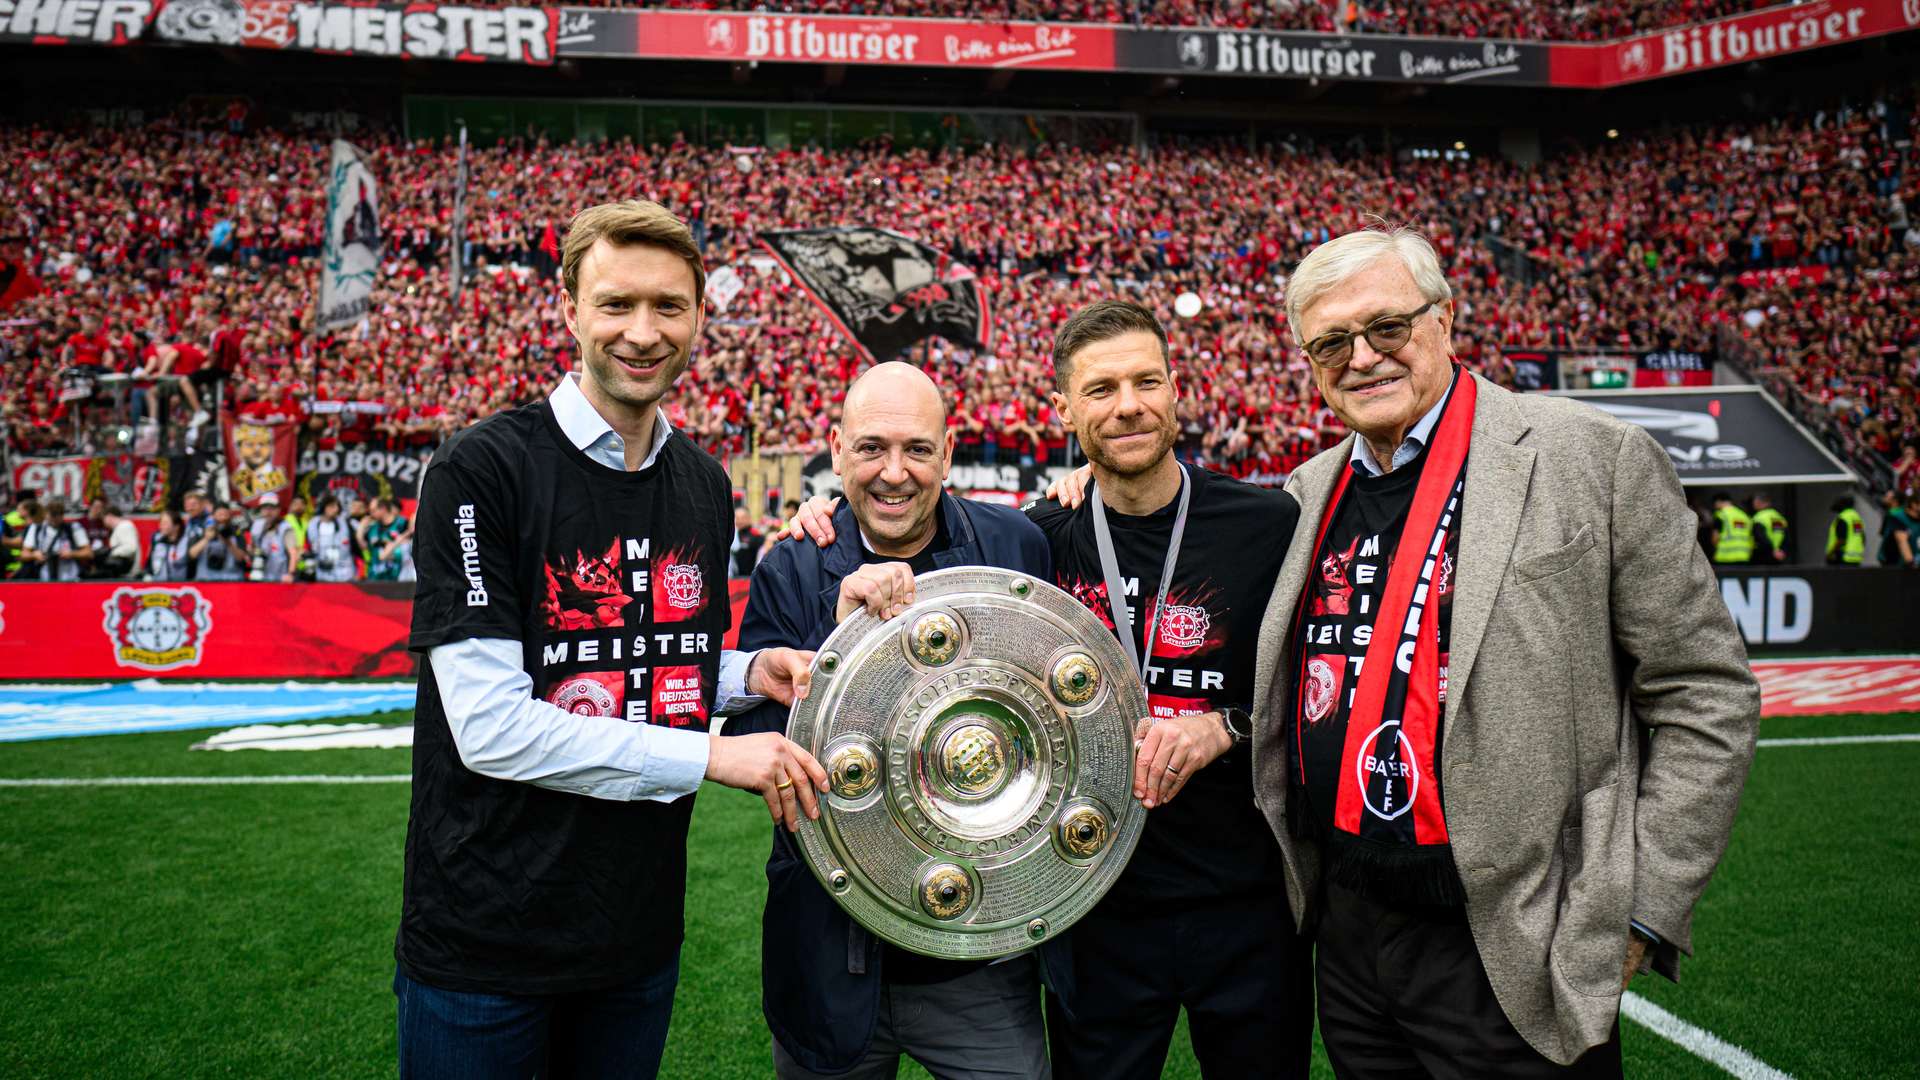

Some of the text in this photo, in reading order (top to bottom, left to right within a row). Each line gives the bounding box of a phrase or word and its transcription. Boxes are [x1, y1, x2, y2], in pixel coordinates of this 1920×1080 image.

[295, 3, 551, 61] MEISTER
[746, 16, 919, 60] Bitburger
[1663, 7, 1865, 73] Bitburger
[1216, 33, 1376, 77] Bitburger
[344, 451, 419, 483] BOYZ
[454, 503, 489, 607] Barmenia
[543, 632, 709, 667] MEISTER
[1153, 705, 1177, 718] WIR.
